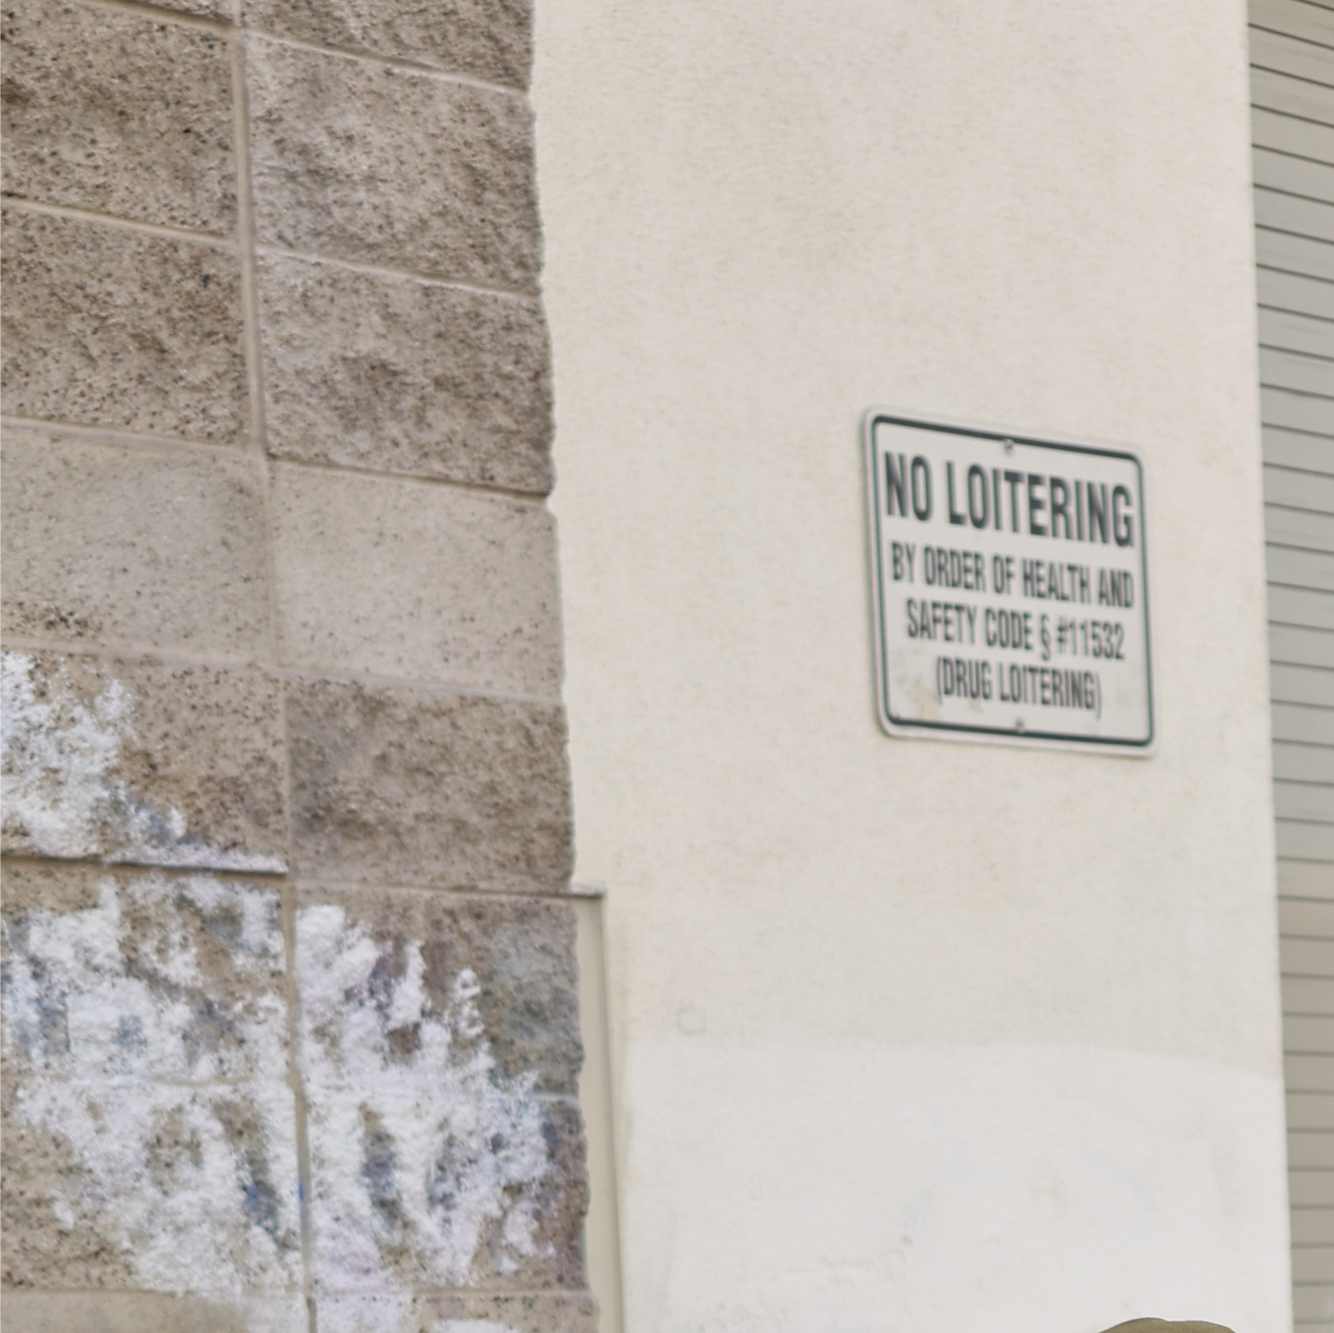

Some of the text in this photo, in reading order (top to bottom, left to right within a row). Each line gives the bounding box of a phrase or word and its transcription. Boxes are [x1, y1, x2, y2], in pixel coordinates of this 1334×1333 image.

[884, 451, 1135, 548] NO LOITERING
[891, 541, 1135, 609] BY ORDER OF HEALTH AND
[907, 597, 977, 645] SAFETY
[985, 608, 1033, 651] CODE
[1057, 615, 1126, 661] #11532
[936, 655, 1102, 720] (DRUG LOITERING)
